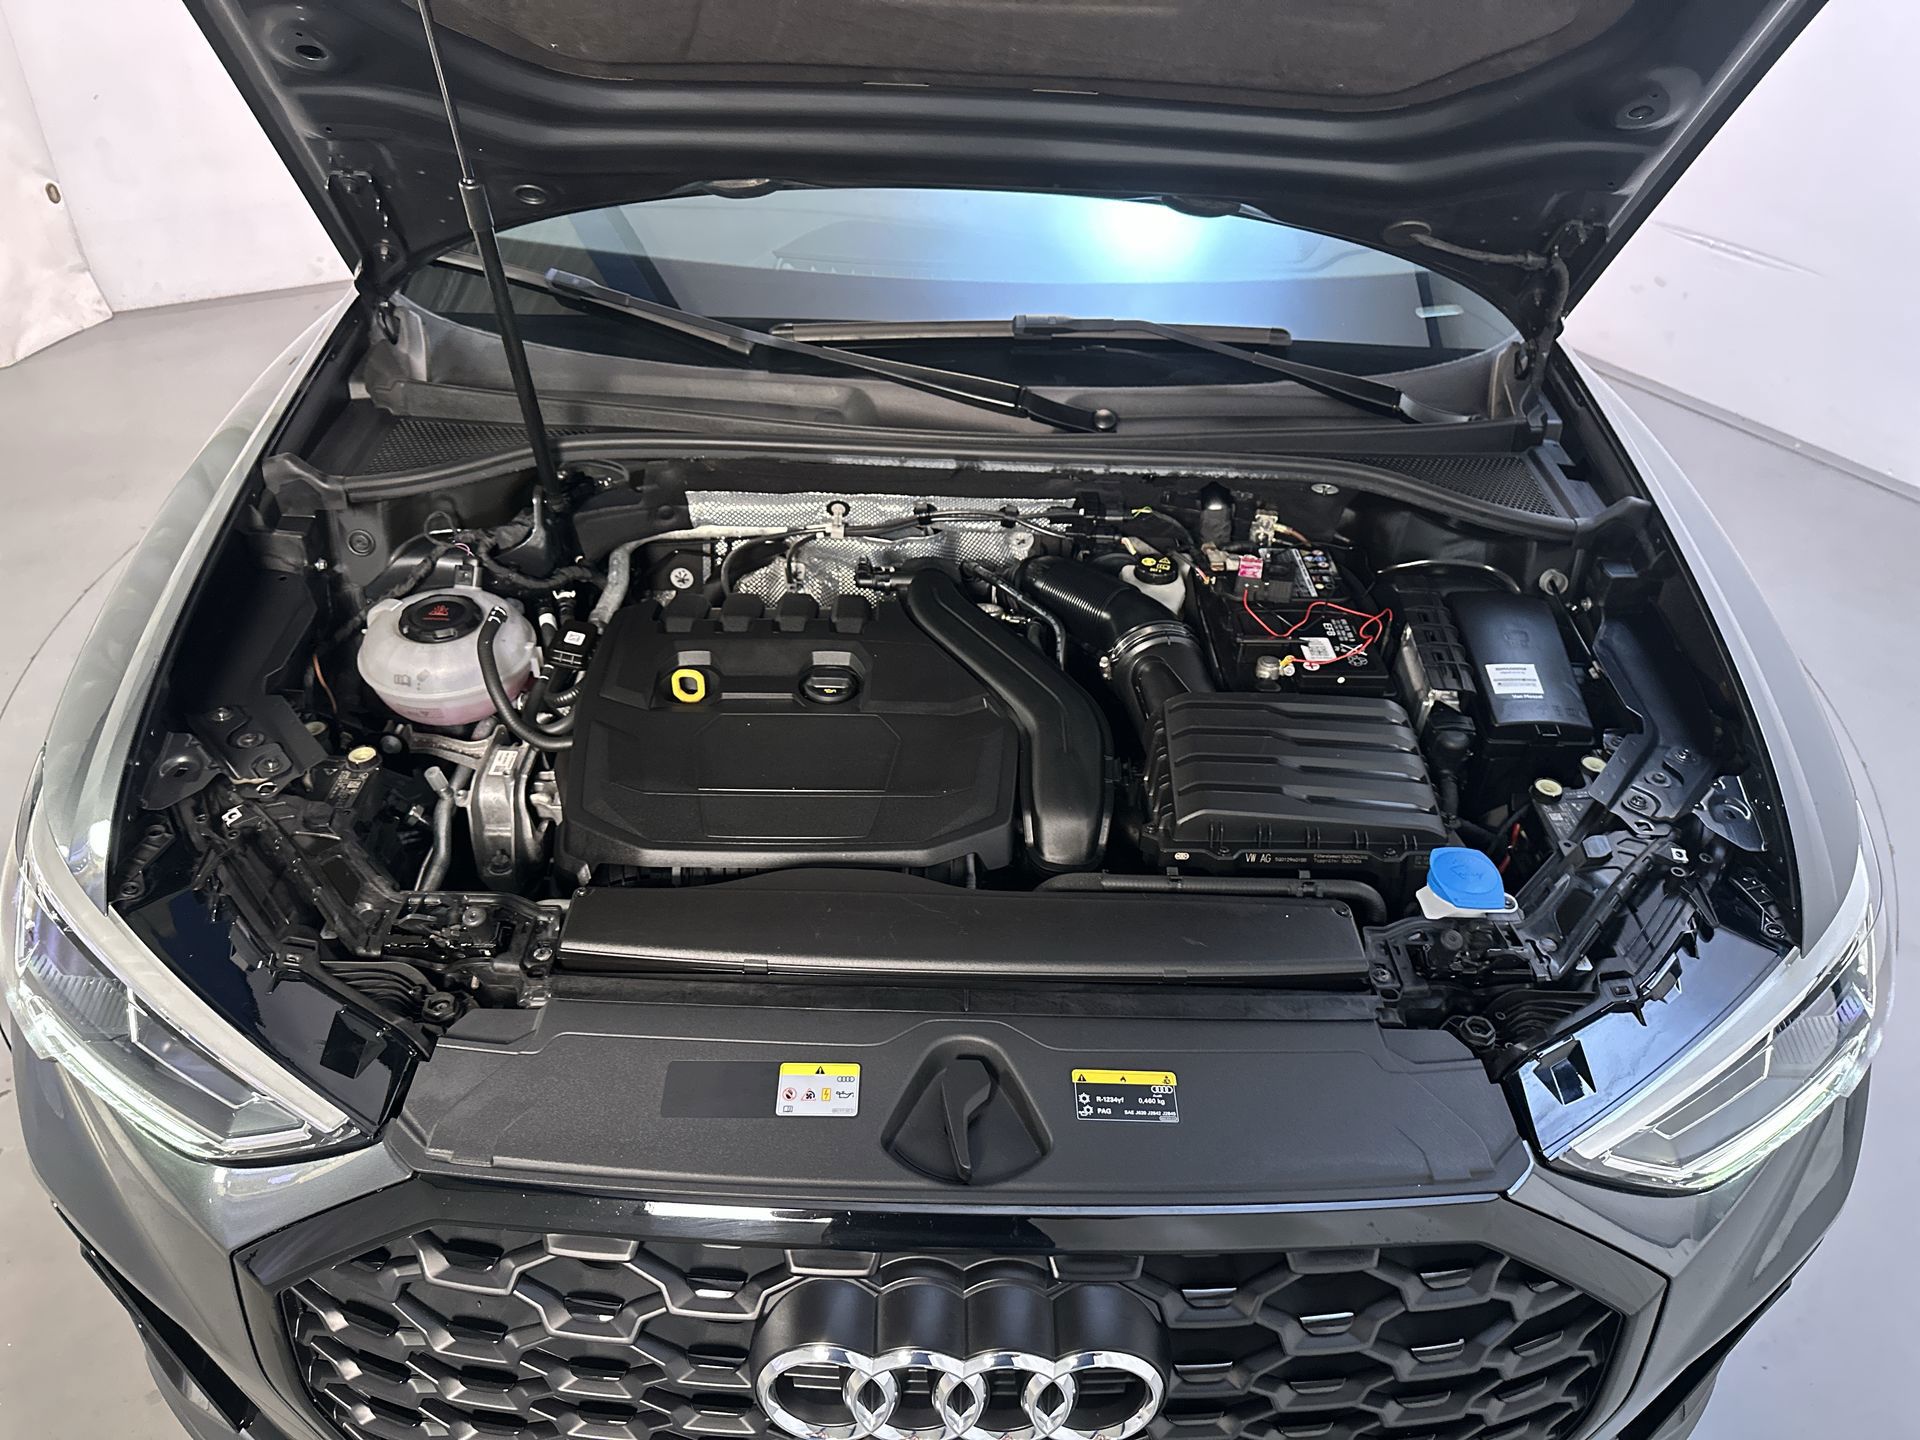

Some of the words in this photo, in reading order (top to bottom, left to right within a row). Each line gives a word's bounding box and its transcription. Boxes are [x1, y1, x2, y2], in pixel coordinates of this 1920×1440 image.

[1245, 852, 1257, 862] VW
[1260, 853, 1271, 863] AG
[1096, 1096, 1124, 1104] R-1234yf
[1157, 1098, 1166, 1106] kg
